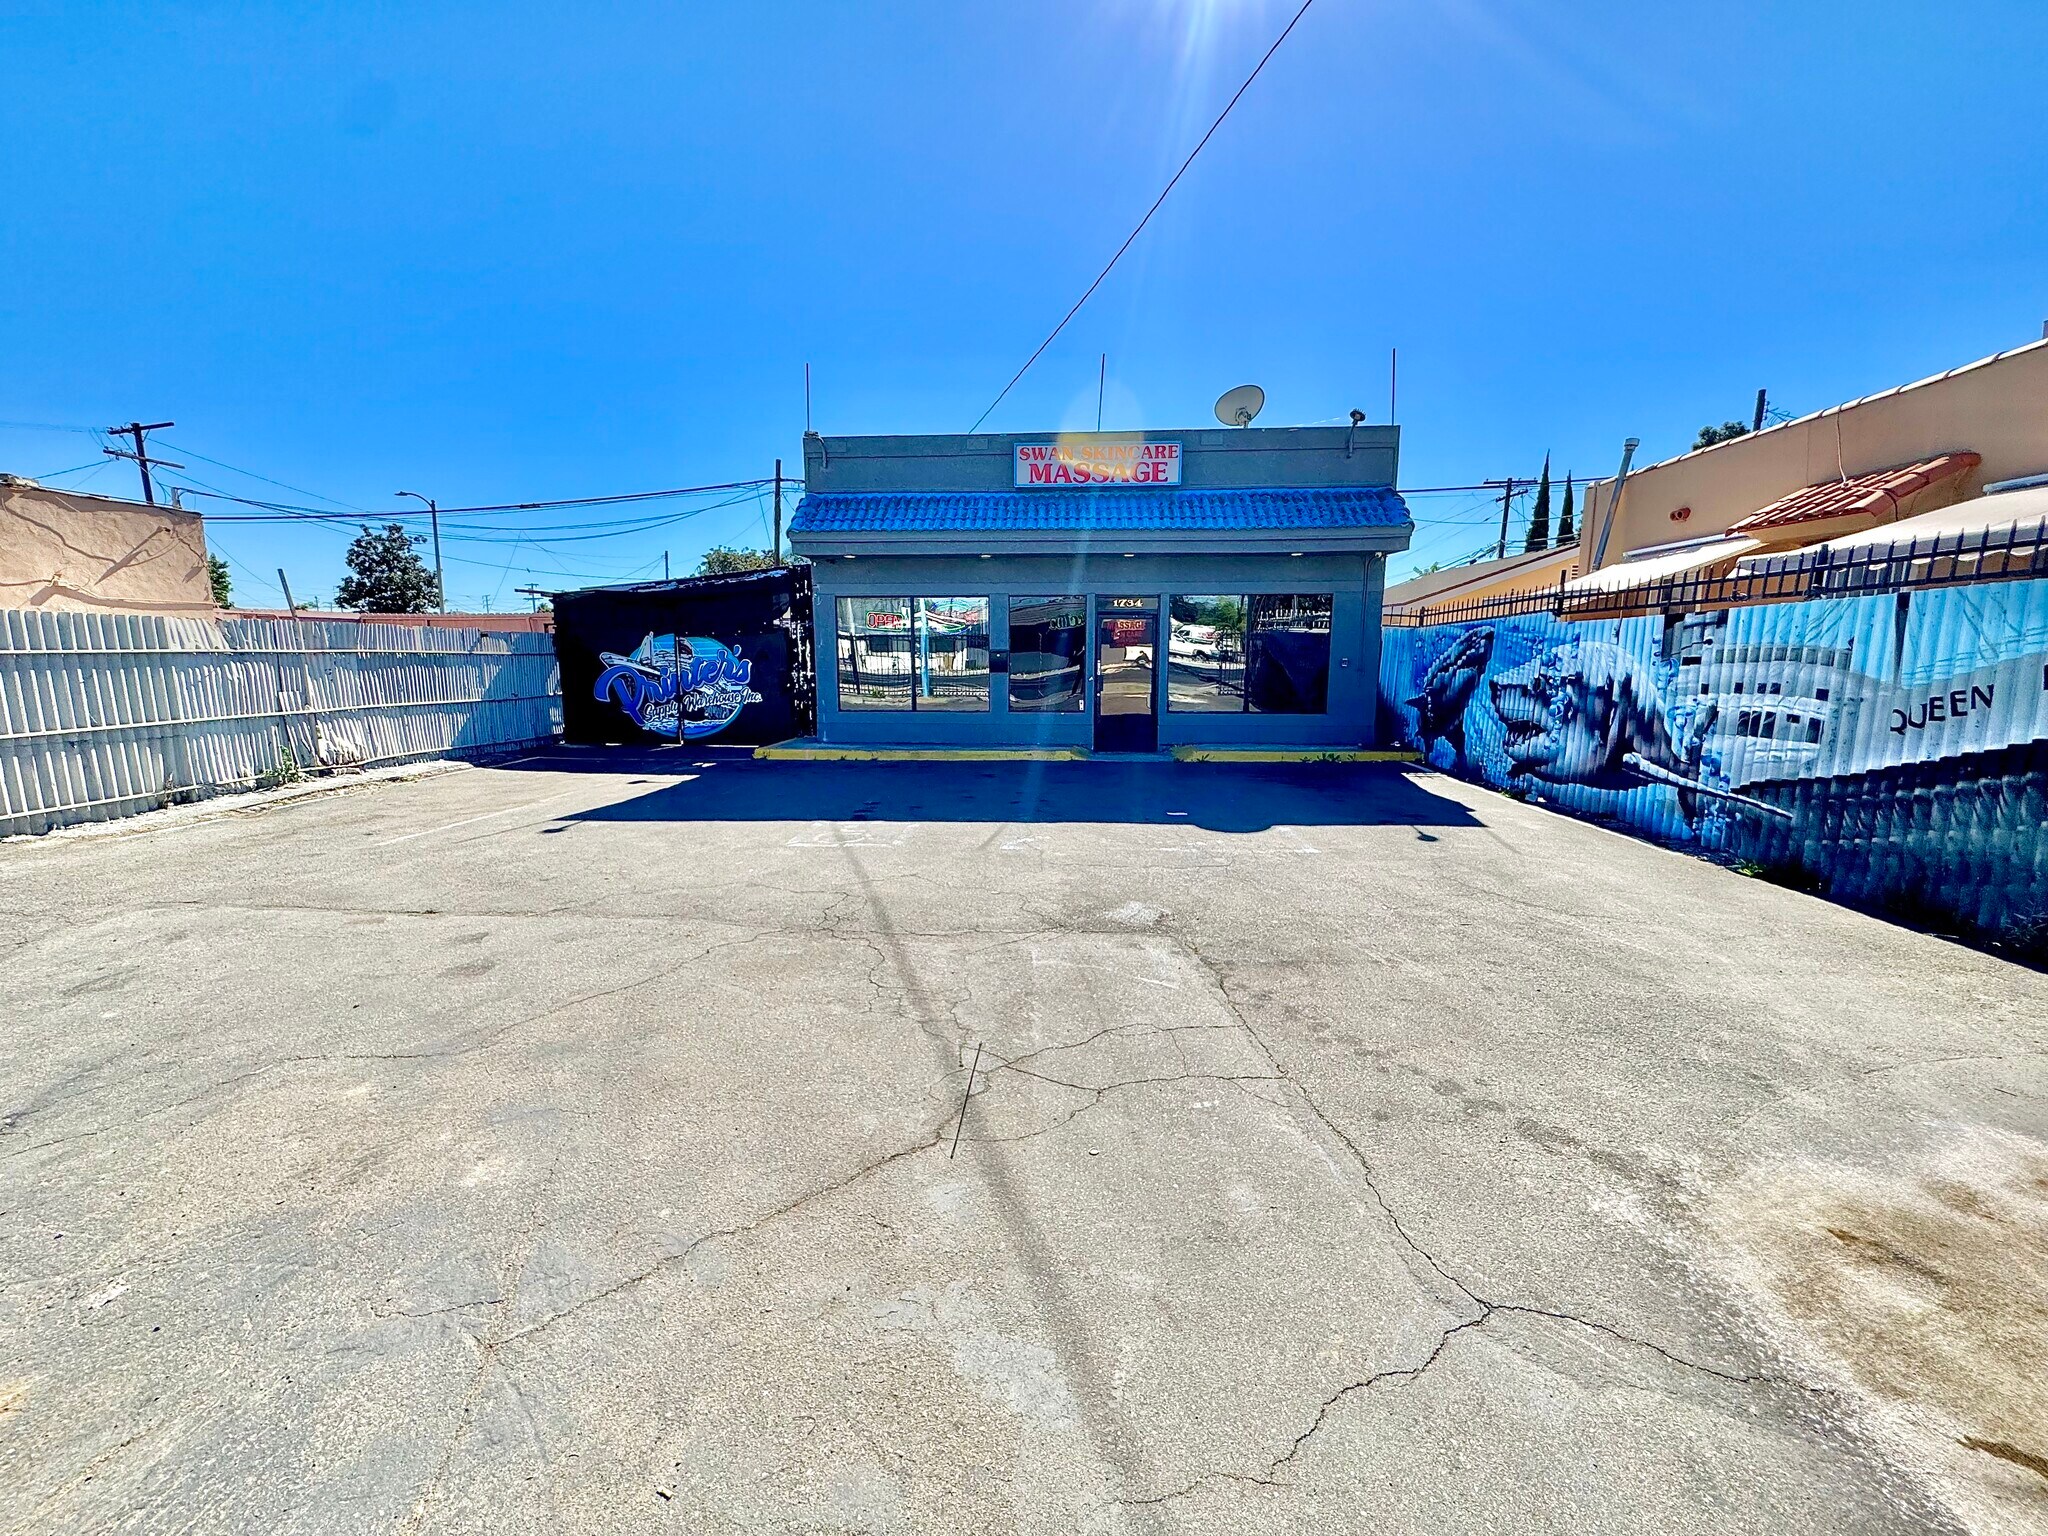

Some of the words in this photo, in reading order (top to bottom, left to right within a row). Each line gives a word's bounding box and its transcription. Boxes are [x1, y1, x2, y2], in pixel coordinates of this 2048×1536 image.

[1019, 446, 1074, 461] SWAN
[1028, 462, 1168, 484] MASSAGE
[1112, 598, 1144, 608] 1734
[868, 613, 903, 629] OPEN
[594, 644, 752, 726] Printer's
[682, 691, 741, 712] Warehouse
[740, 686, 763, 704] Inc.
[1890, 683, 1995, 735] QUEEN
